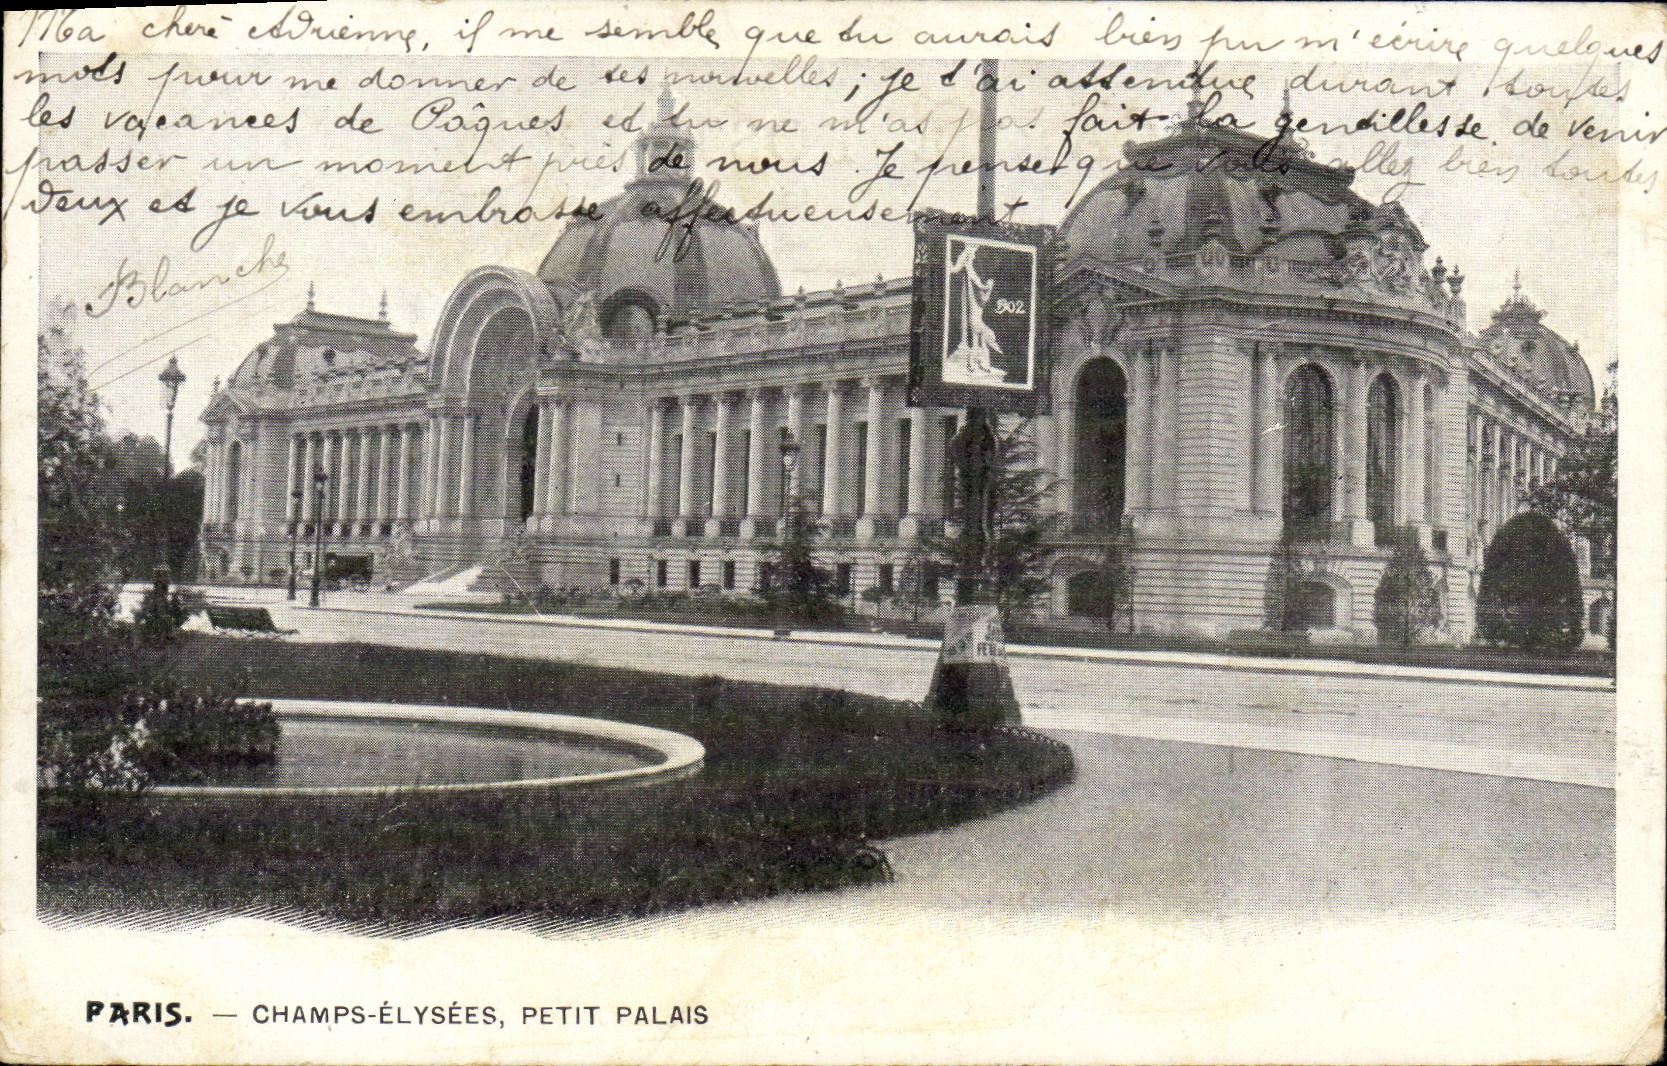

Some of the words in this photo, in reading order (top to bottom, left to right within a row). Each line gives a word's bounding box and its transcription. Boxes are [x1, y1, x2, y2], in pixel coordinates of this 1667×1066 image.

[18, 8, 105, 48] Ma
[454, 10, 494, 53] il
[500, 26, 563, 41] me
[585, 9, 720, 49] semble
[744, 26, 822, 86] que
[838, 15, 893, 44] tu
[914, 21, 1061, 47] aurais
[1095, 11, 1182, 51] bien
[1198, 25, 1285, 78] pu
[14, 51, 126, 84] mots
[282, 70, 339, 91] me
[358, 67, 516, 92] donner
[531, 65, 577, 91] de
[1289, 64, 1456, 98] durant
[20, 92, 76, 128] les
[103, 106, 300, 134] vacances
[334, 102, 384, 134] de
[602, 102, 646, 132] et
[749, 118, 798, 132] ne
[1513, 111, 1550, 139] de
[1567, 111, 1666, 144] venir
[203, 157, 304, 172] un
[315, 144, 532, 174] moment
[648, 142, 691, 173] de
[1438, 145, 1520, 184] bien
[149, 187, 199, 214] et
[190, 194, 260, 252] je
[399, 185, 604, 225] embrasse
